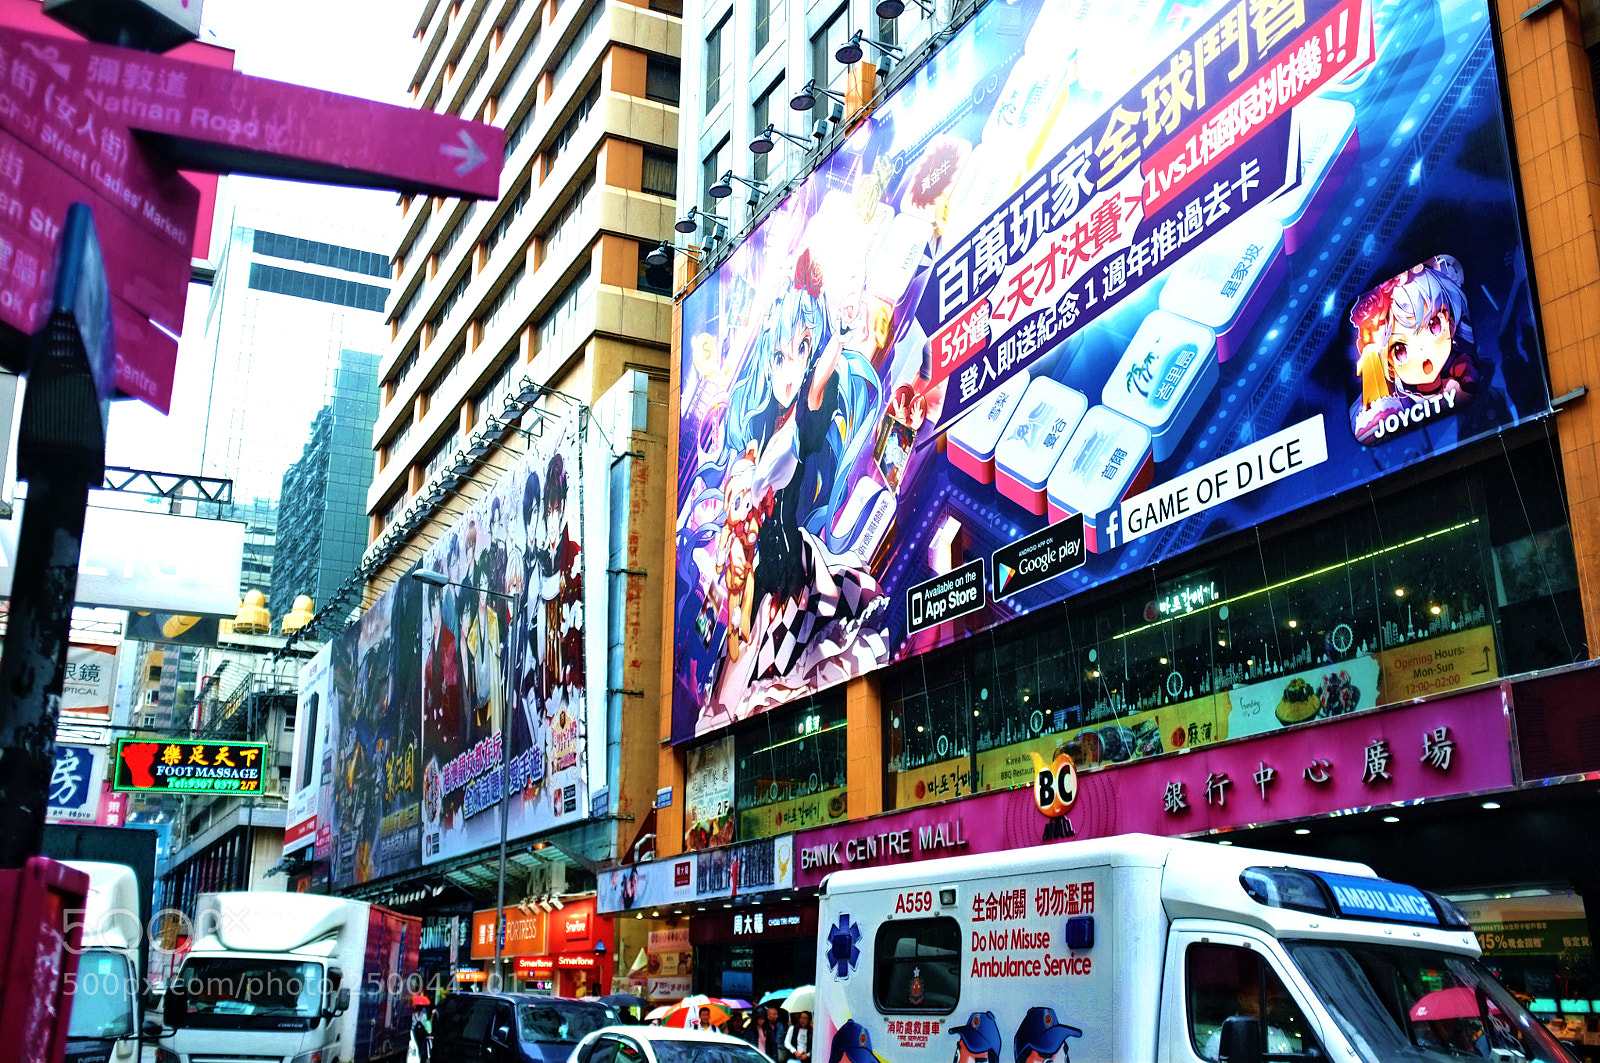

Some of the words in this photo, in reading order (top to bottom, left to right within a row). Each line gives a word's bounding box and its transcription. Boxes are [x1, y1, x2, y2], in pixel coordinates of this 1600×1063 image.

[0, 46, 37, 98] 街
[87, 55, 188, 98] 彌敦道
[84, 88, 182, 124] Nathan
[191, 106, 260, 139] Road
[41, 124, 87, 169] Street
[1220, 243, 1264, 299] 星家坡
[1154, 349, 1196, 402] 峇里島
[1373, 388, 1457, 440] JOYCITY
[1043, 416, 1068, 451] 曼谷
[1100, 446, 1129, 481] 首爾
[1127, 487, 1191, 535] GAME
[1196, 469, 1229, 506] OF
[1236, 438, 1304, 490] DICE
[1018, 548, 1057, 577] Google
[1058, 538, 1081, 563] play
[924, 580, 954, 602] Available
[955, 577, 964, 589] on
[965, 571, 977, 585] the
[925, 598, 948, 622] App
[948, 586, 977, 611] Store
[1394, 653, 1433, 671] Opening
[1434, 646, 1465, 660] Hours:
[1413, 662, 1454, 679] Mon-Sun
[62, 686, 99, 697] PTICAL
[161, 743, 259, 768] 樂足天下
[1005, 755, 1021, 767] Korea
[1162, 725, 1456, 814] 銀行中心廣場
[156, 765, 194, 777] FOOT
[195, 767, 259, 779] MASSAGE
[240, 780, 259, 790] 2/F
[1000, 770, 1012, 781] BBQ
[1039, 764, 1074, 808] BC
[801, 843, 842, 870] BANK
[846, 830, 910, 863] CENTRE
[919, 820, 966, 850] MALL
[895, 890, 933, 914] A559
[972, 888, 1027, 923] 生命攸關
[1035, 881, 1096, 917] 切勿濫用
[1333, 885, 1437, 918] AMBULANCE
[507, 918, 537, 942] FORTRESS
[733, 912, 764, 936] 周大福
[972, 930, 986, 952] Do
[989, 929, 1009, 951] Not
[1011, 928, 1050, 950] Misuse
[519, 959, 553, 969] SmarTone
[558, 956, 594, 966] SmarTone
[971, 955, 1041, 978] Ambulance
[1044, 953, 1092, 977] Service
[887, 1020, 940, 1036] 消防處救護車
[900, 1041, 927, 1049] AMBULANCE
